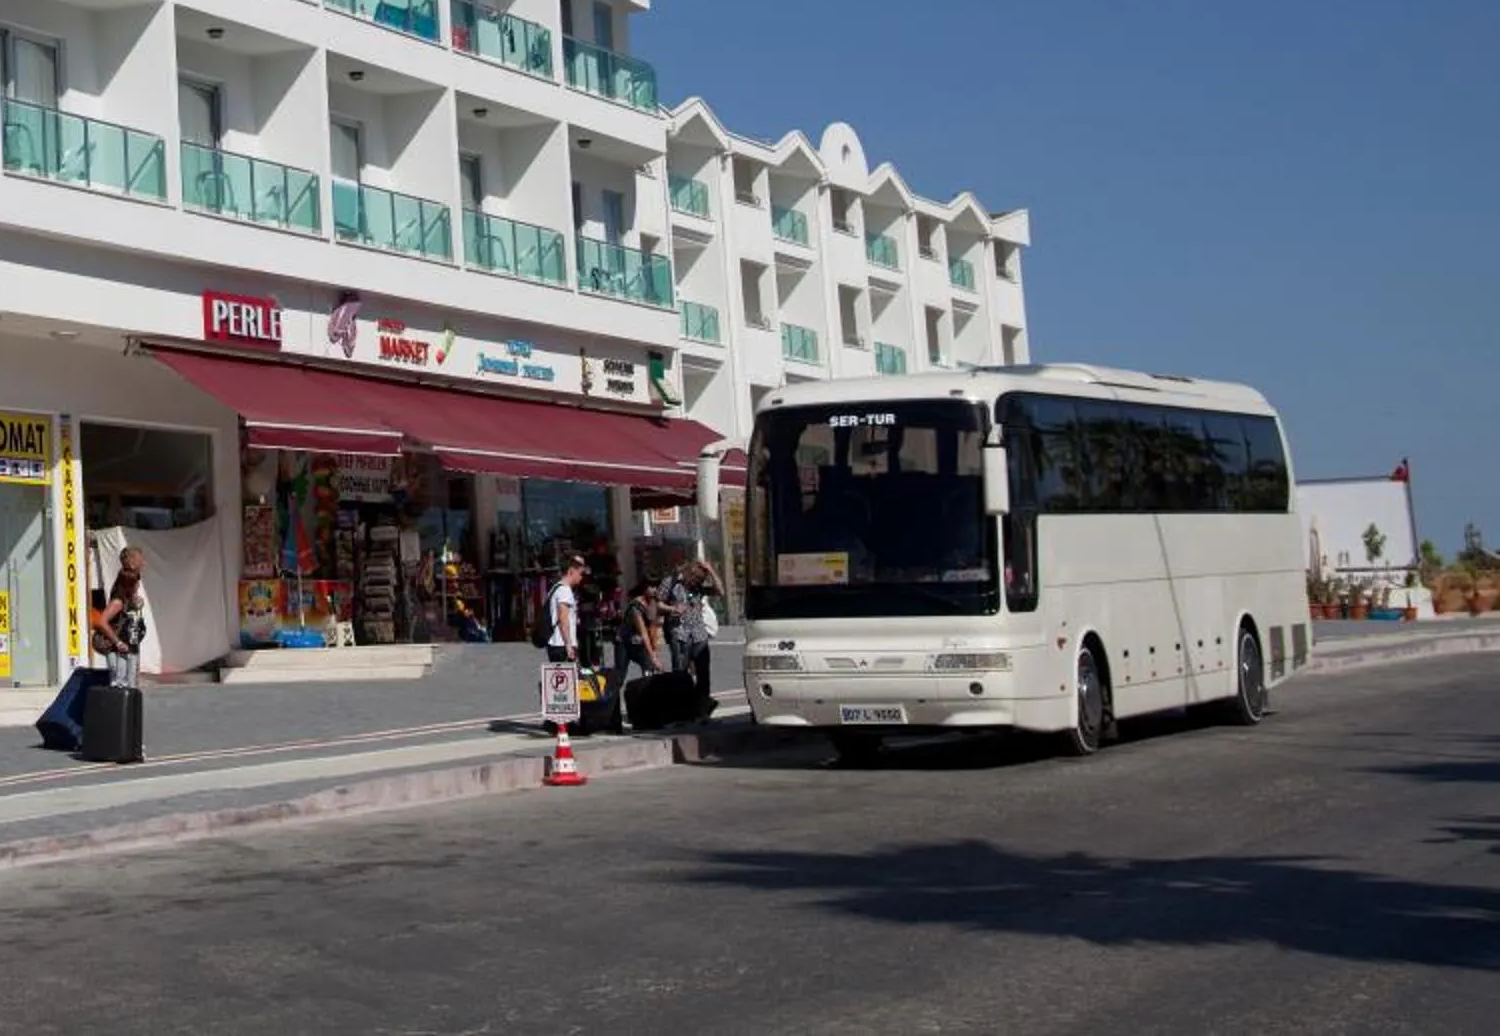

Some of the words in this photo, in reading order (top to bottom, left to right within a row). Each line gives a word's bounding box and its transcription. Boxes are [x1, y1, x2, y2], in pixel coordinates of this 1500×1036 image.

[212, 299, 283, 340] PERLE
[380, 336, 429, 365] MARKET
[829, 414, 896, 427] SER-TUR
[63, 447, 74, 528] CASH
[67, 542, 78, 649] POINT
